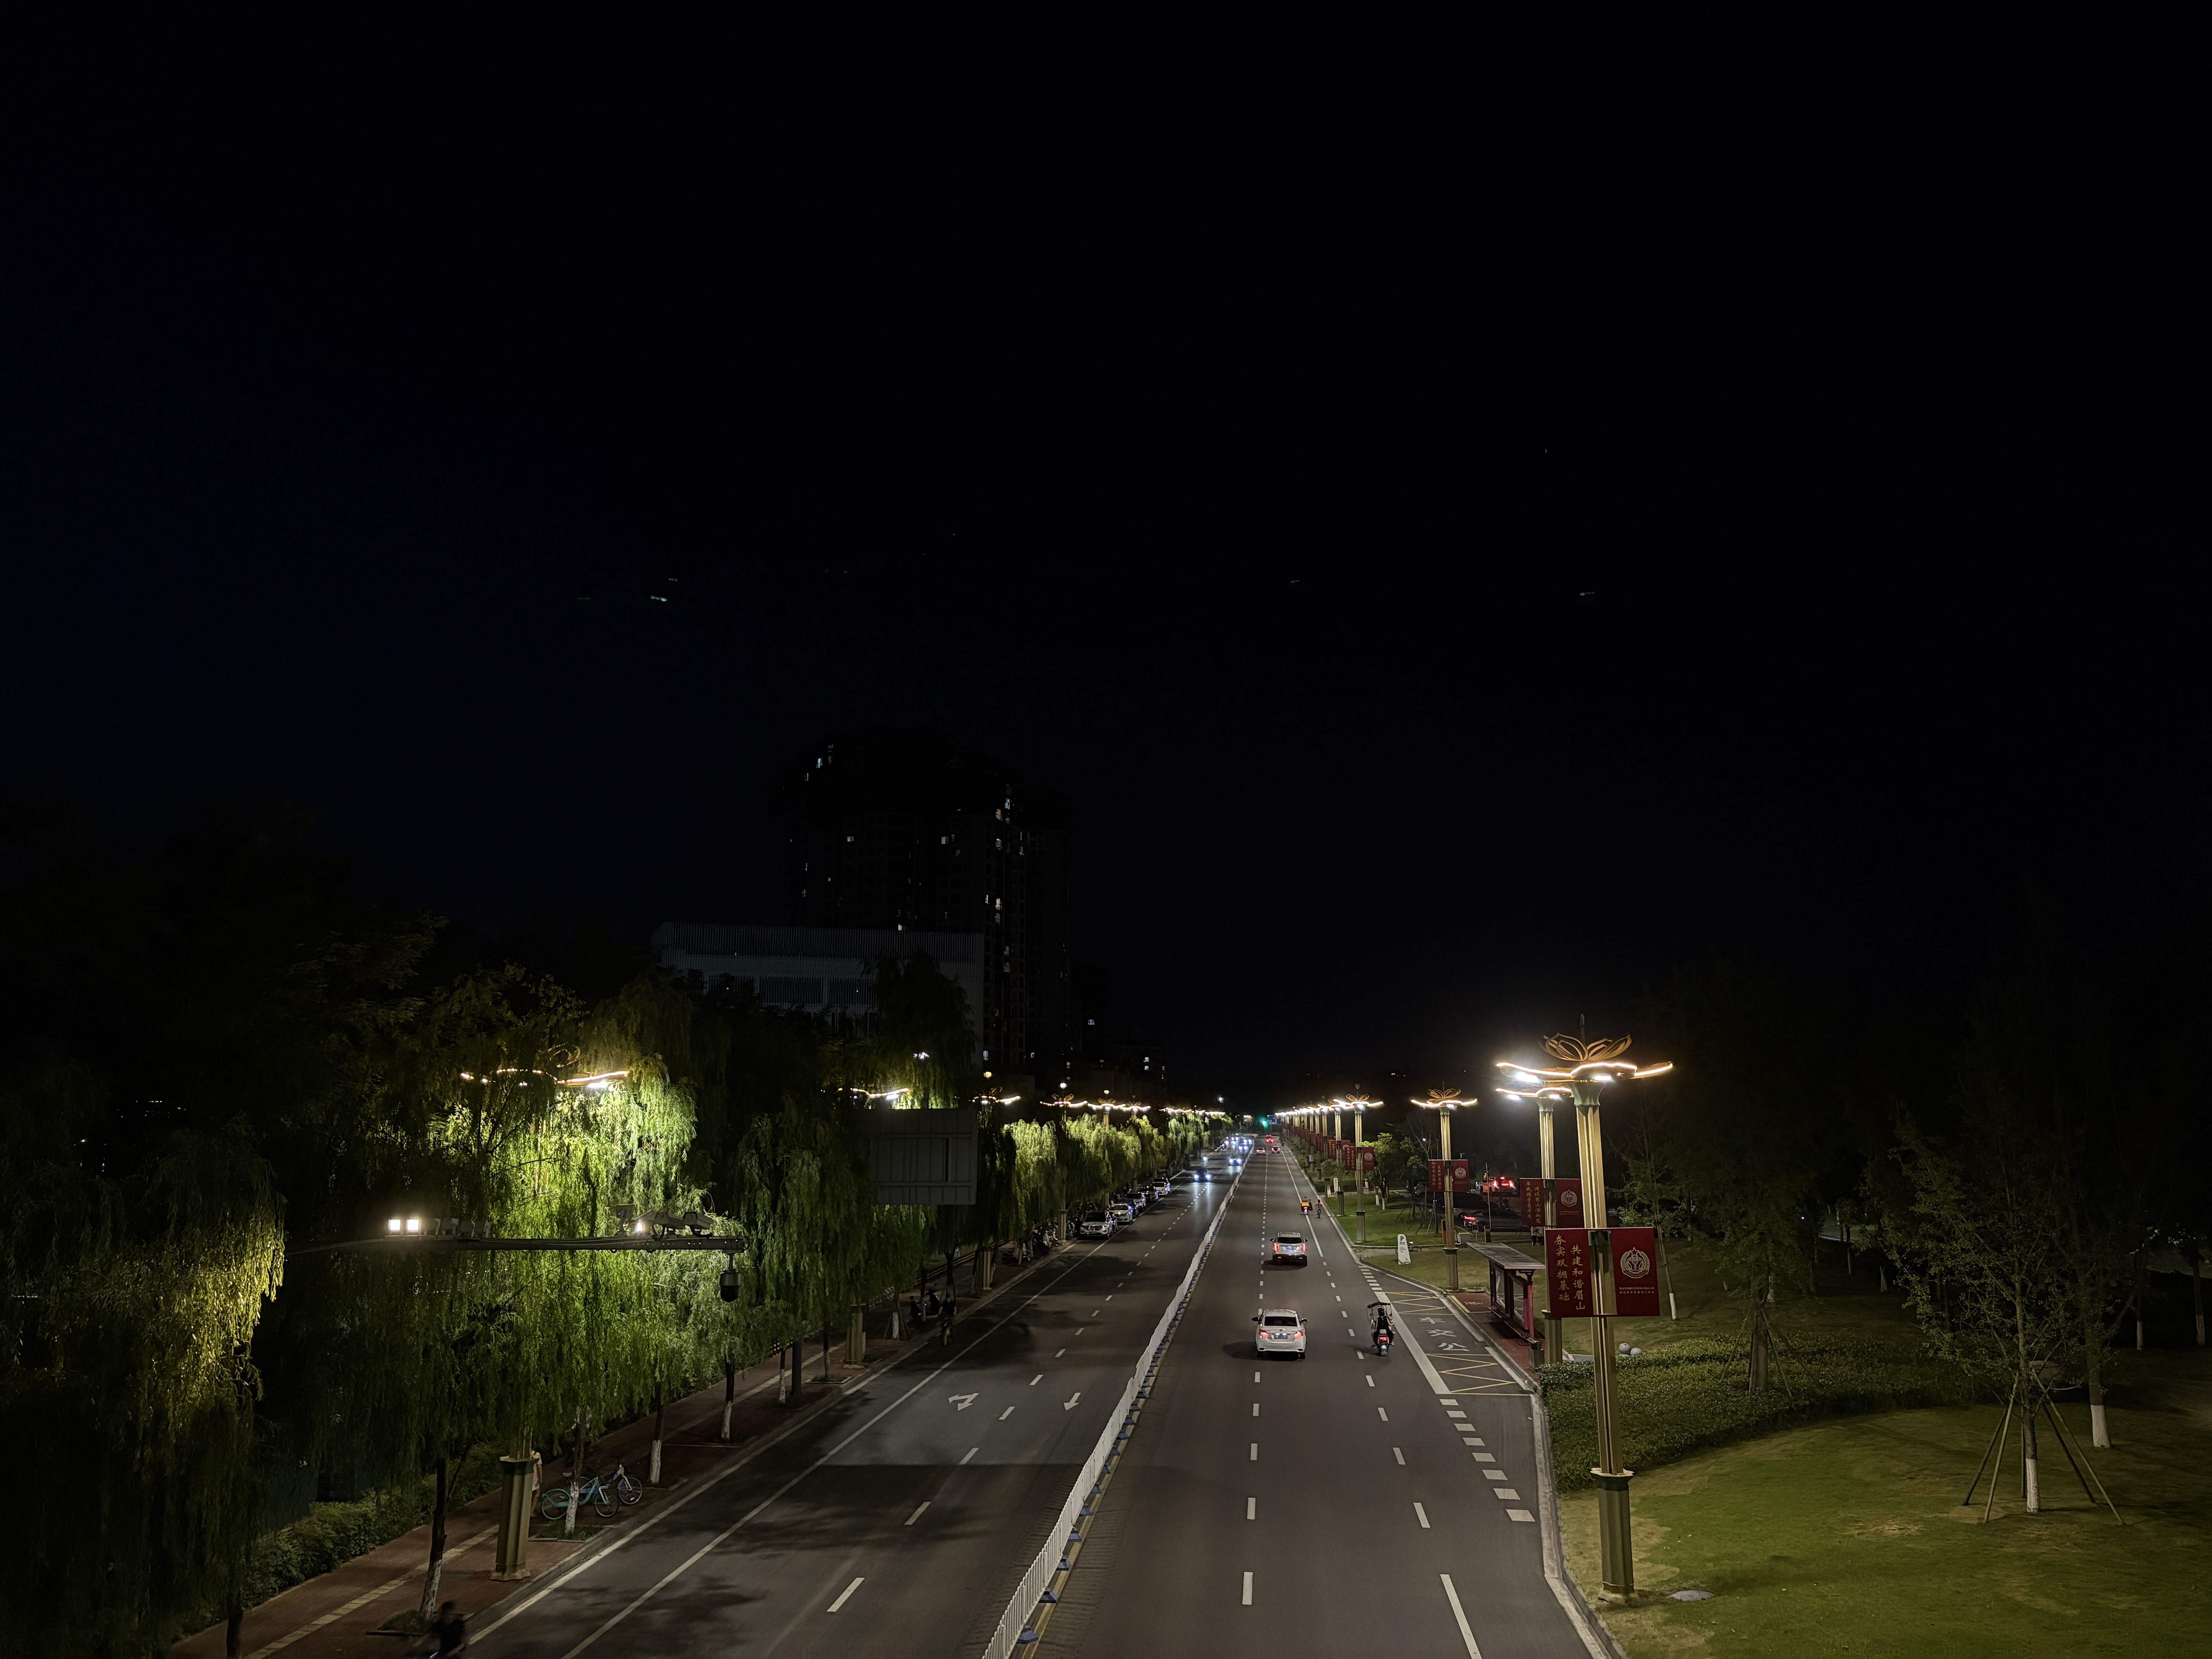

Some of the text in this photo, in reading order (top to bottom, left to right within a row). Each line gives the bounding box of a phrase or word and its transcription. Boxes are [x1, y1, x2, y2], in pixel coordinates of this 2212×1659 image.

[1554, 1234, 1570, 1301] 夯实双拥基础
[1570, 1244, 1585, 1310] 共建和谐眉山
